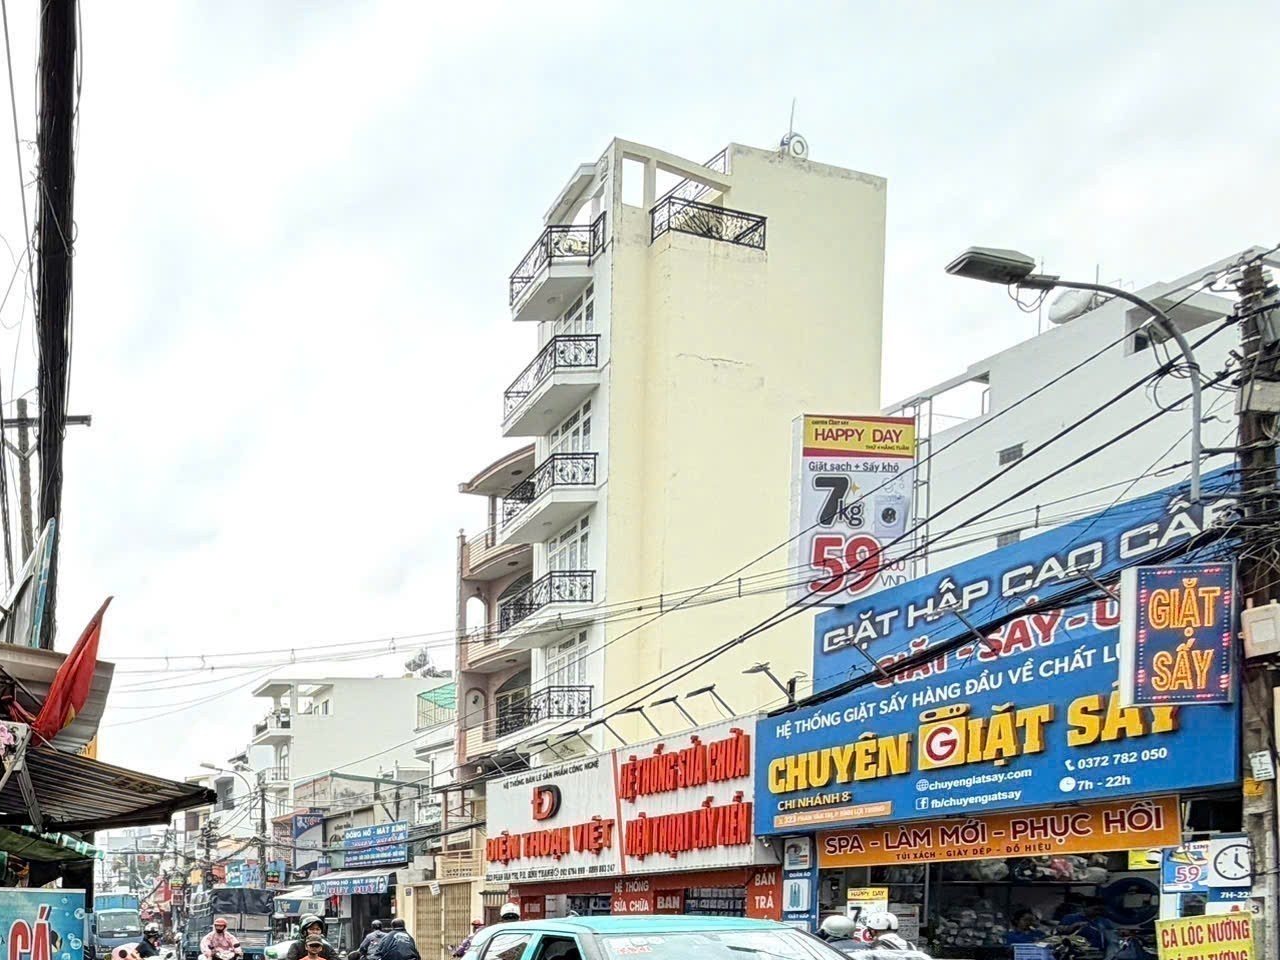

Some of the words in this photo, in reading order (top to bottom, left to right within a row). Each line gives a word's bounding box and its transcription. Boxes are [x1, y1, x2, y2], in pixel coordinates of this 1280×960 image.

[815, 428, 865, 442] HAPPY
[872, 429, 903, 443] DAY
[808, 461, 827, 472] Giặt
[830, 462, 852, 472] sạch
[862, 462, 880, 473] Sấy
[808, 535, 881, 593] 59
[1002, 541, 1103, 597] CAO
[1148, 577, 1221, 637] GIẶT
[1152, 638, 1214, 692] SẤY
[776, 720, 792, 739] HỆ
[795, 710, 841, 733] THỐNG
[843, 702, 877, 723] GIẶT
[879, 692, 909, 715] SẤY
[912, 682, 961, 708] HÀNG
[966, 669, 1003, 696] ĐẦU
[1008, 658, 1034, 684] VỀ
[1039, 644, 1097, 678] CHẤT
[768, 731, 913, 794] CHUYÊN
[1078, 755, 1109, 769] 0372
[1113, 752, 1138, 766] 782
[1141, 748, 1168, 761] 050
[620, 755, 637, 804] HỆ
[637, 743, 678, 796] THỐNG
[1078, 779, 1093, 791] 7h
[1104, 775, 1131, 788] 22h
[777, 798, 796, 811] CHI
[797, 791, 840, 808] NHÁNH
[573, 815, 615, 855] VIỆT
[825, 834, 865, 856] SPA
[884, 825, 932, 851] LÀM
[939, 819, 988, 848] MỚI
[1010, 812, 1093, 845] PHỤC
[1103, 801, 1164, 834] HỒI
[896, 852, 910, 860] TÚI
[914, 850, 936, 860] XÁCH
[946, 847, 968, 857] GIÀY
[972, 845, 992, 855] DÉP
[625, 878, 649, 892] THỐNG
[1176, 865, 1201, 883] 59
[630, 899, 650, 912] CHỮA
[755, 890, 774, 909] TRẢ
[1161, 924, 1177, 949] CÁ
[1181, 921, 1204, 946] LÓC
[1207, 917, 1250, 943] NƯỚNG
